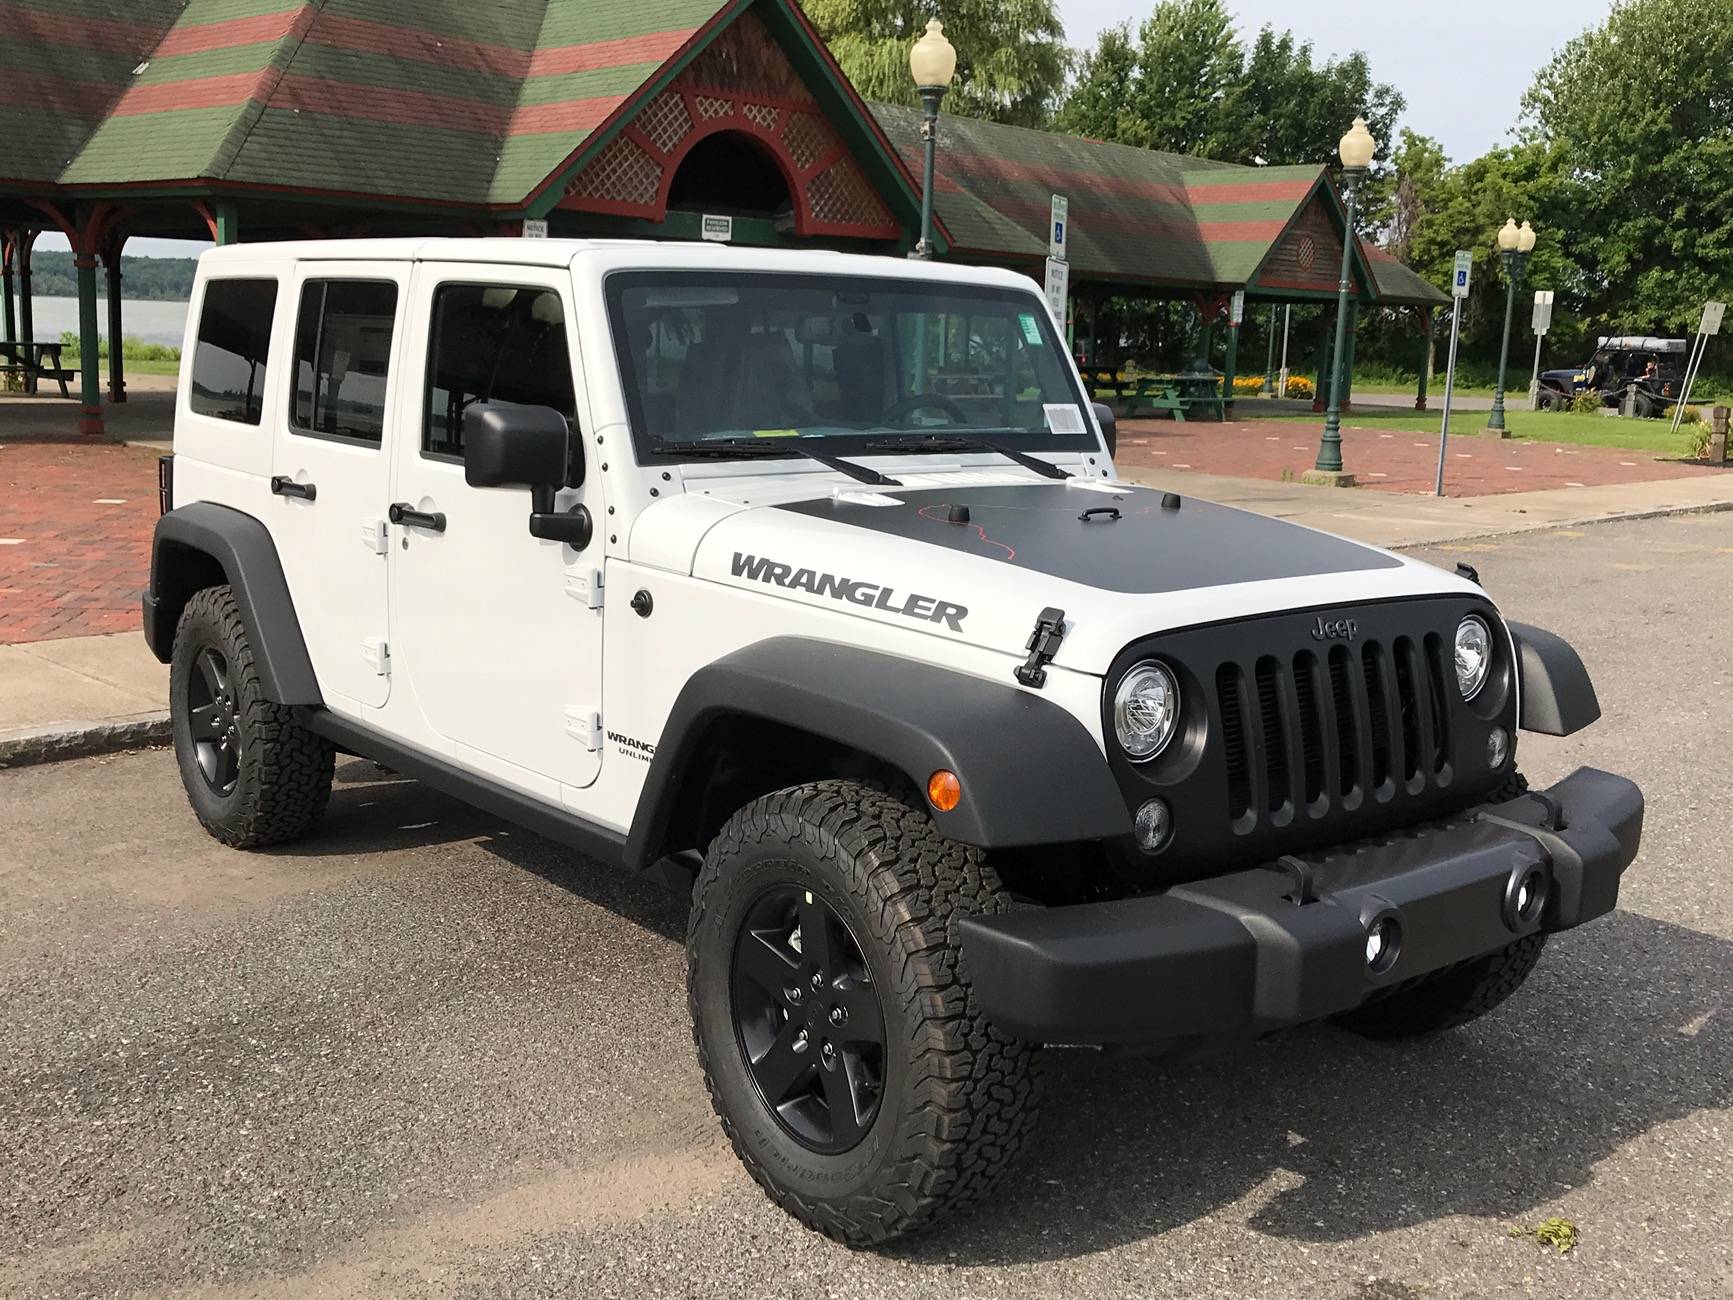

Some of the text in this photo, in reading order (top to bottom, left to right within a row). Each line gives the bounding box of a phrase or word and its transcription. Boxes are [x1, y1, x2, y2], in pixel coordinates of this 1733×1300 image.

[731, 552, 968, 632] WRANGLER
[1311, 616, 1358, 641] Jeep
[607, 730, 656, 754] WRANG
